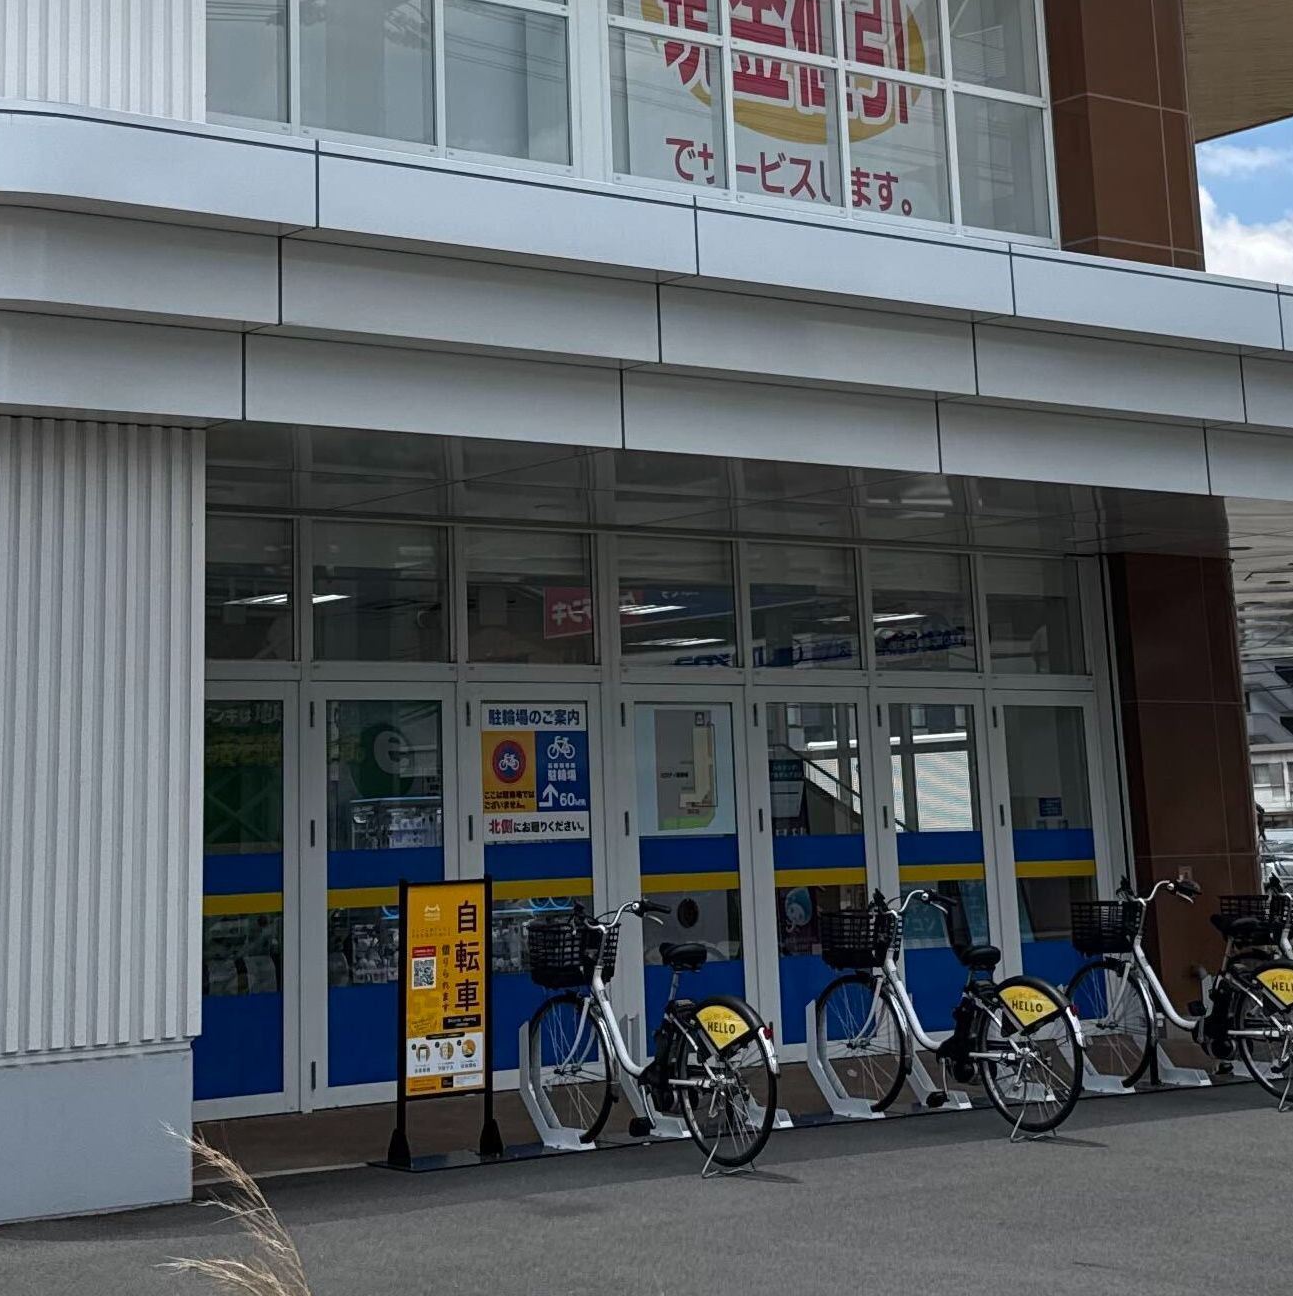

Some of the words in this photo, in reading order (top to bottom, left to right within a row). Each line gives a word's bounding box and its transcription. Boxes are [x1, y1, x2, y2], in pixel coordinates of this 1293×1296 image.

[488, 708, 580, 725] 駐輪場のご案内
[454, 900, 480, 1011] 自転車
[1011, 999, 1044, 1013] HELLO
[707, 1020, 737, 1035] HELLO
